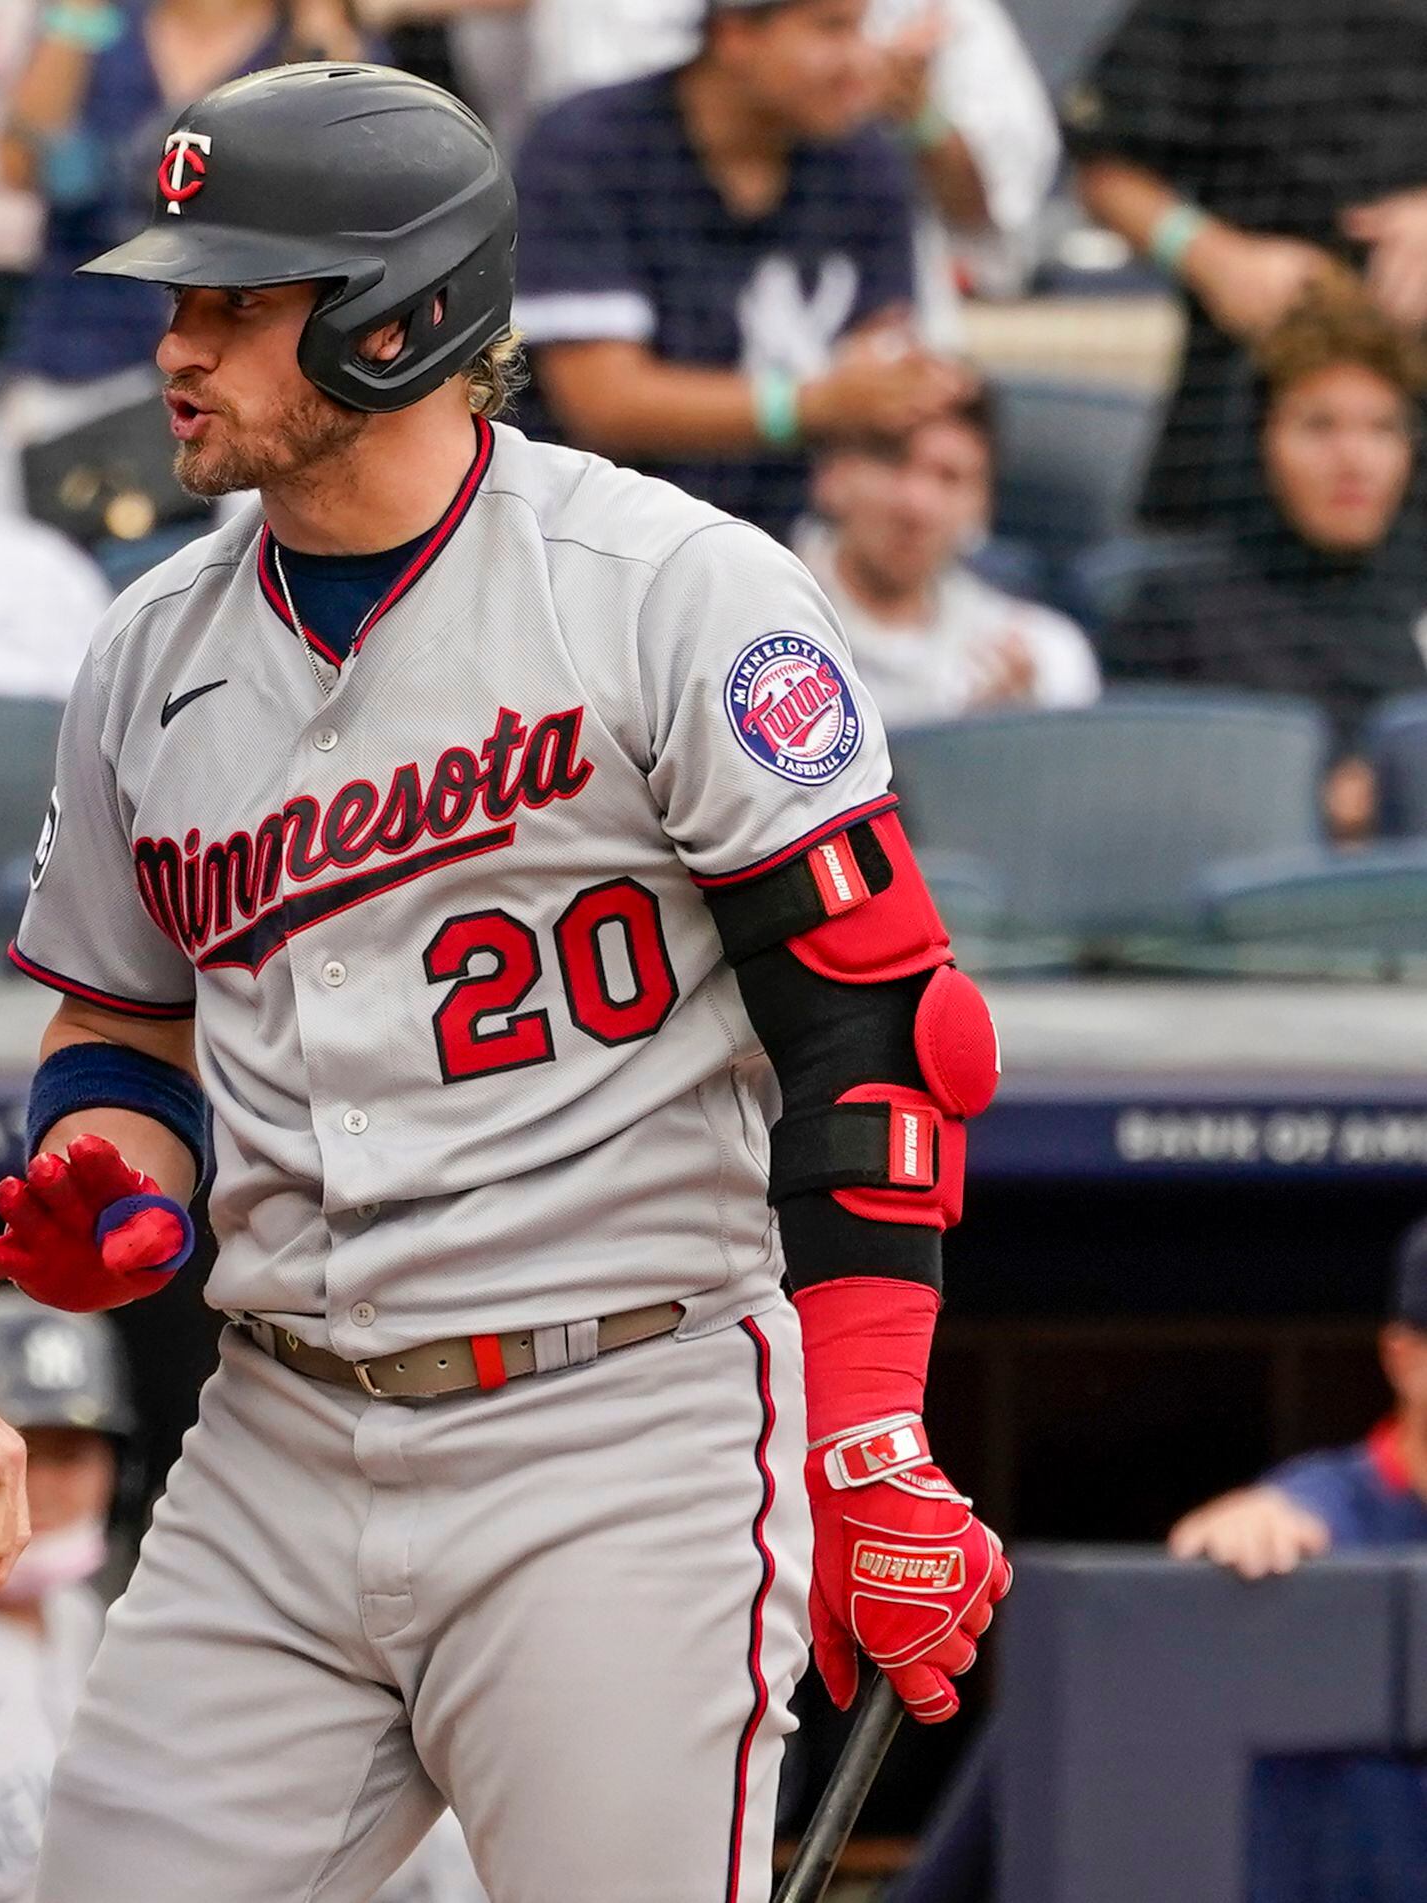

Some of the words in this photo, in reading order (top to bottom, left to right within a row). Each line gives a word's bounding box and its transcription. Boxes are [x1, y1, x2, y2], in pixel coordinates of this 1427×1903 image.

[733, 640, 823, 705] MINNESOTA
[741, 662, 841, 755] Twins
[839, 716, 857, 755] CLUB
[775, 754, 840, 777] BASEBALL
[134, 706, 595, 955] Minnesota
[817, 844, 854, 902] marucci
[422, 875, 679, 1085] 20
[900, 1112, 919, 1177] marucci
[1116, 1110, 1258, 1163] BANK
[1264, 1112, 1331, 1164] OF
[858, 1551, 959, 1587] Franklin
